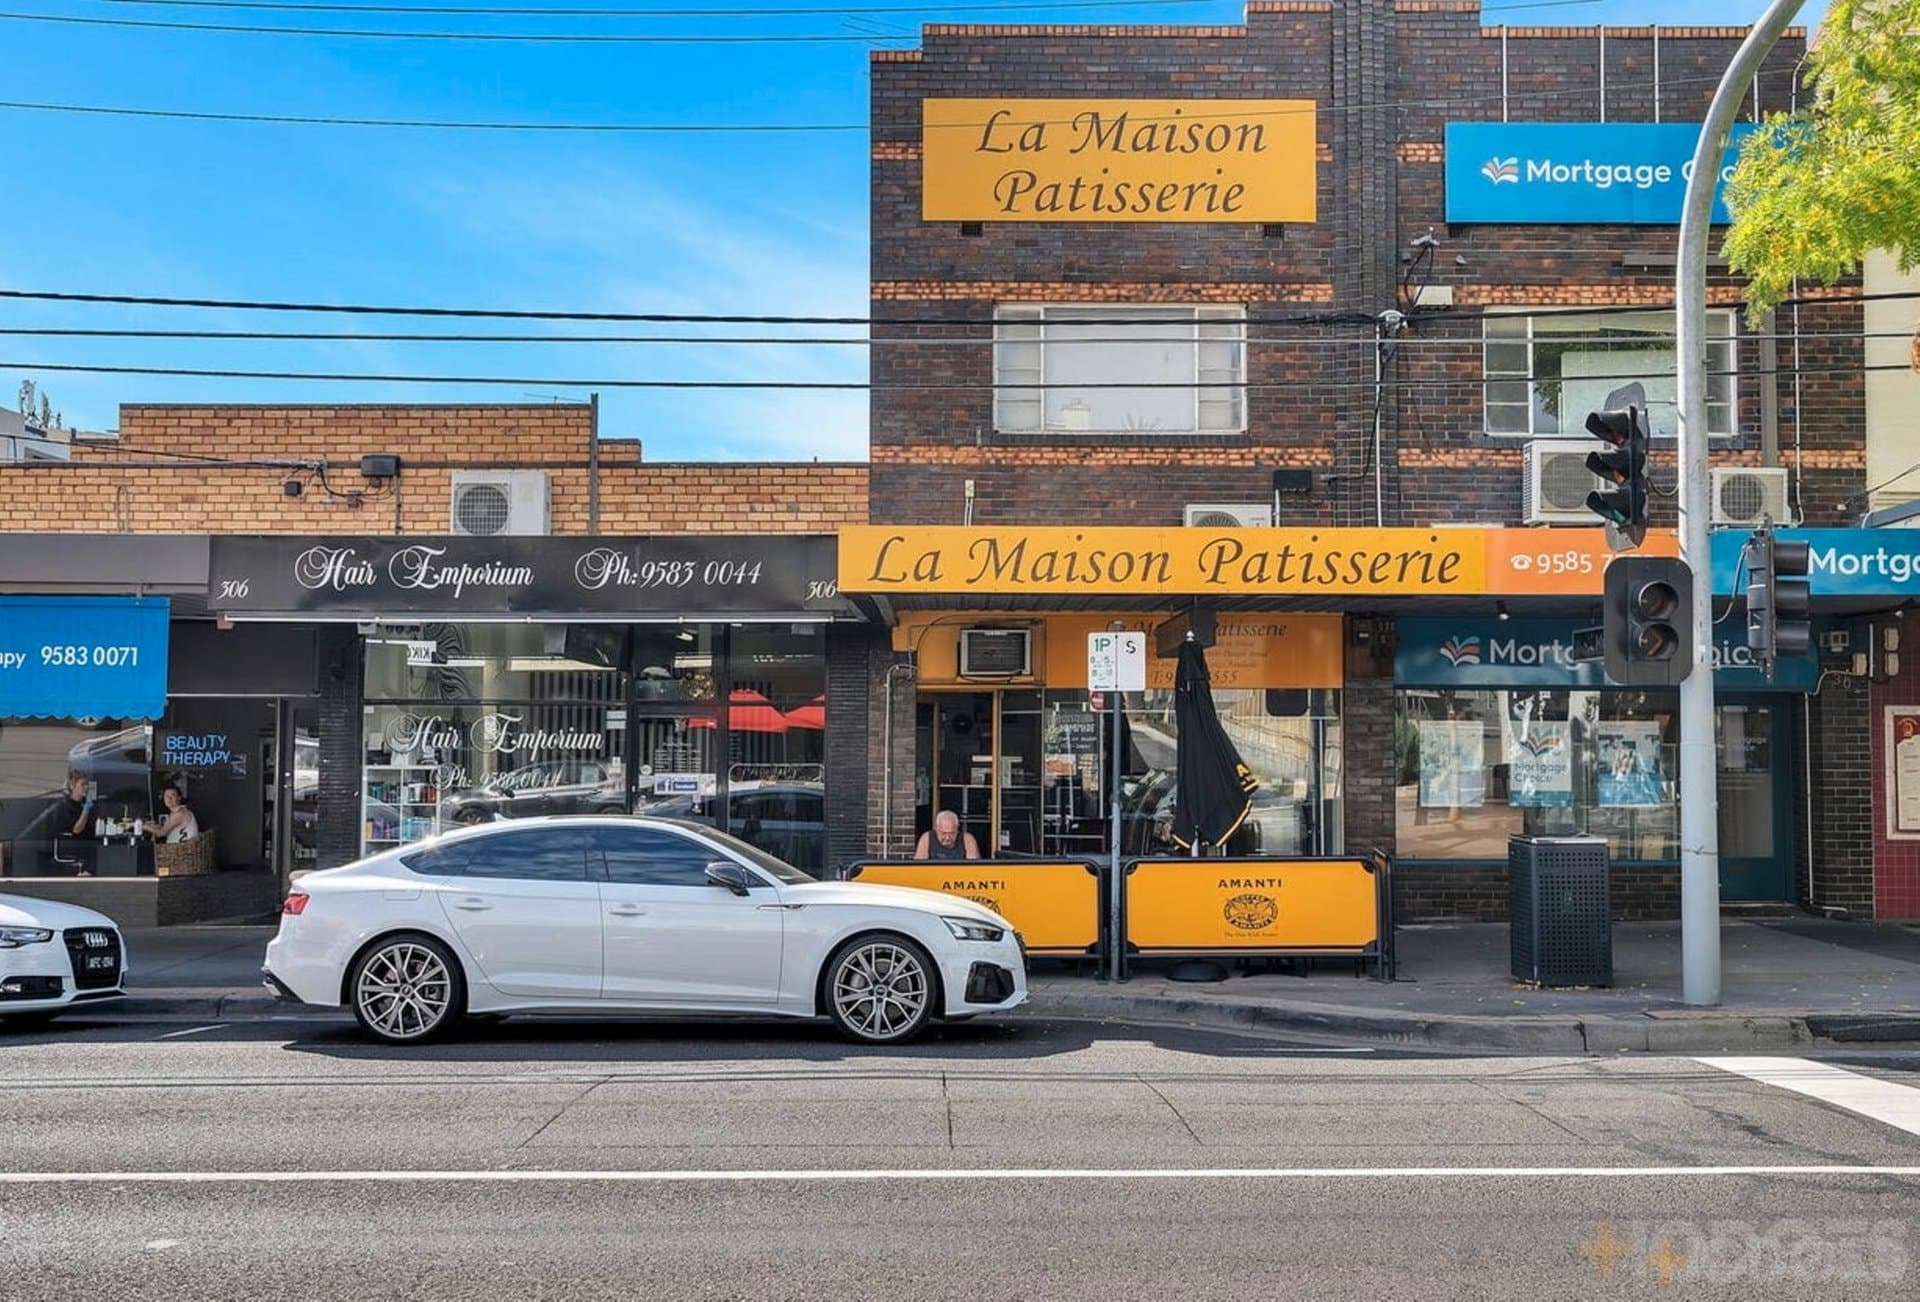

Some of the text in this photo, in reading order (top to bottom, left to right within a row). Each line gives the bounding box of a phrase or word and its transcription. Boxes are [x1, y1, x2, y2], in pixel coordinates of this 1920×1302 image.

[976, 108, 1267, 154] La Maison
[1527, 159, 1671, 188] Mortgage
[993, 168, 1245, 213] Patisserie
[867, 534, 1461, 585] La Maison Patisserie
[1537, 551, 1592, 574] 9585
[295, 546, 535, 599] Hair Emporium
[703, 561, 762, 585] 0044
[216, 578, 249, 600] 306
[805, 579, 836, 601] 306
[1094, 637, 1111, 652] 1P
[0, 646, 138, 669] py 9583 0071
[166, 735, 227, 750] BEAUTY
[386, 713, 461, 752] Hair
[470, 713, 604, 762] Emporium
[163, 751, 230, 766] THERAPY
[942, 881, 1005, 890] AMANTI
[1218, 879, 1282, 888] AMANTI
